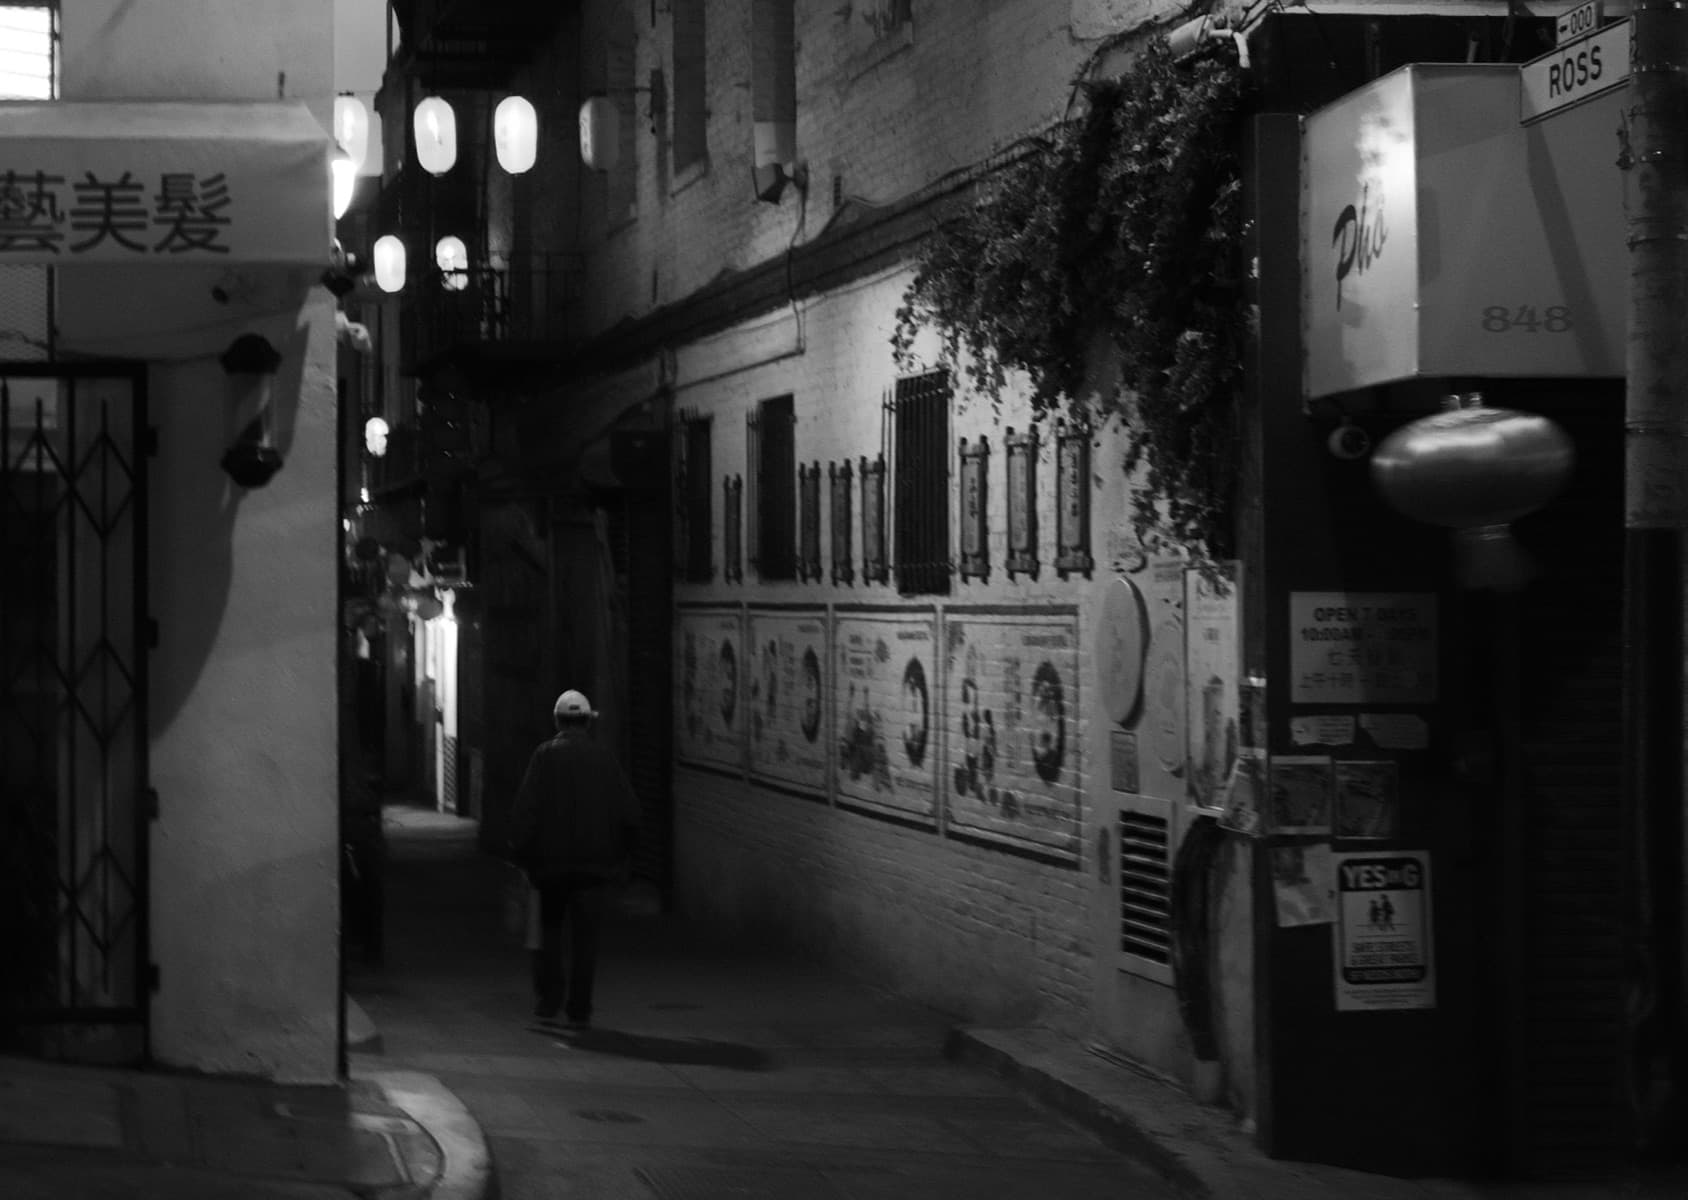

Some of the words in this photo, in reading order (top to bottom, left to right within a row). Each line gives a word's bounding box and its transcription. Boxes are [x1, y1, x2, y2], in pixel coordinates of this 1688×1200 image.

[1549, 44, 1604, 100] ROSS
[1481, 303, 1576, 335] 848
[1314, 607, 1358, 622] OPEN
[1342, 864, 1386, 889] YES
